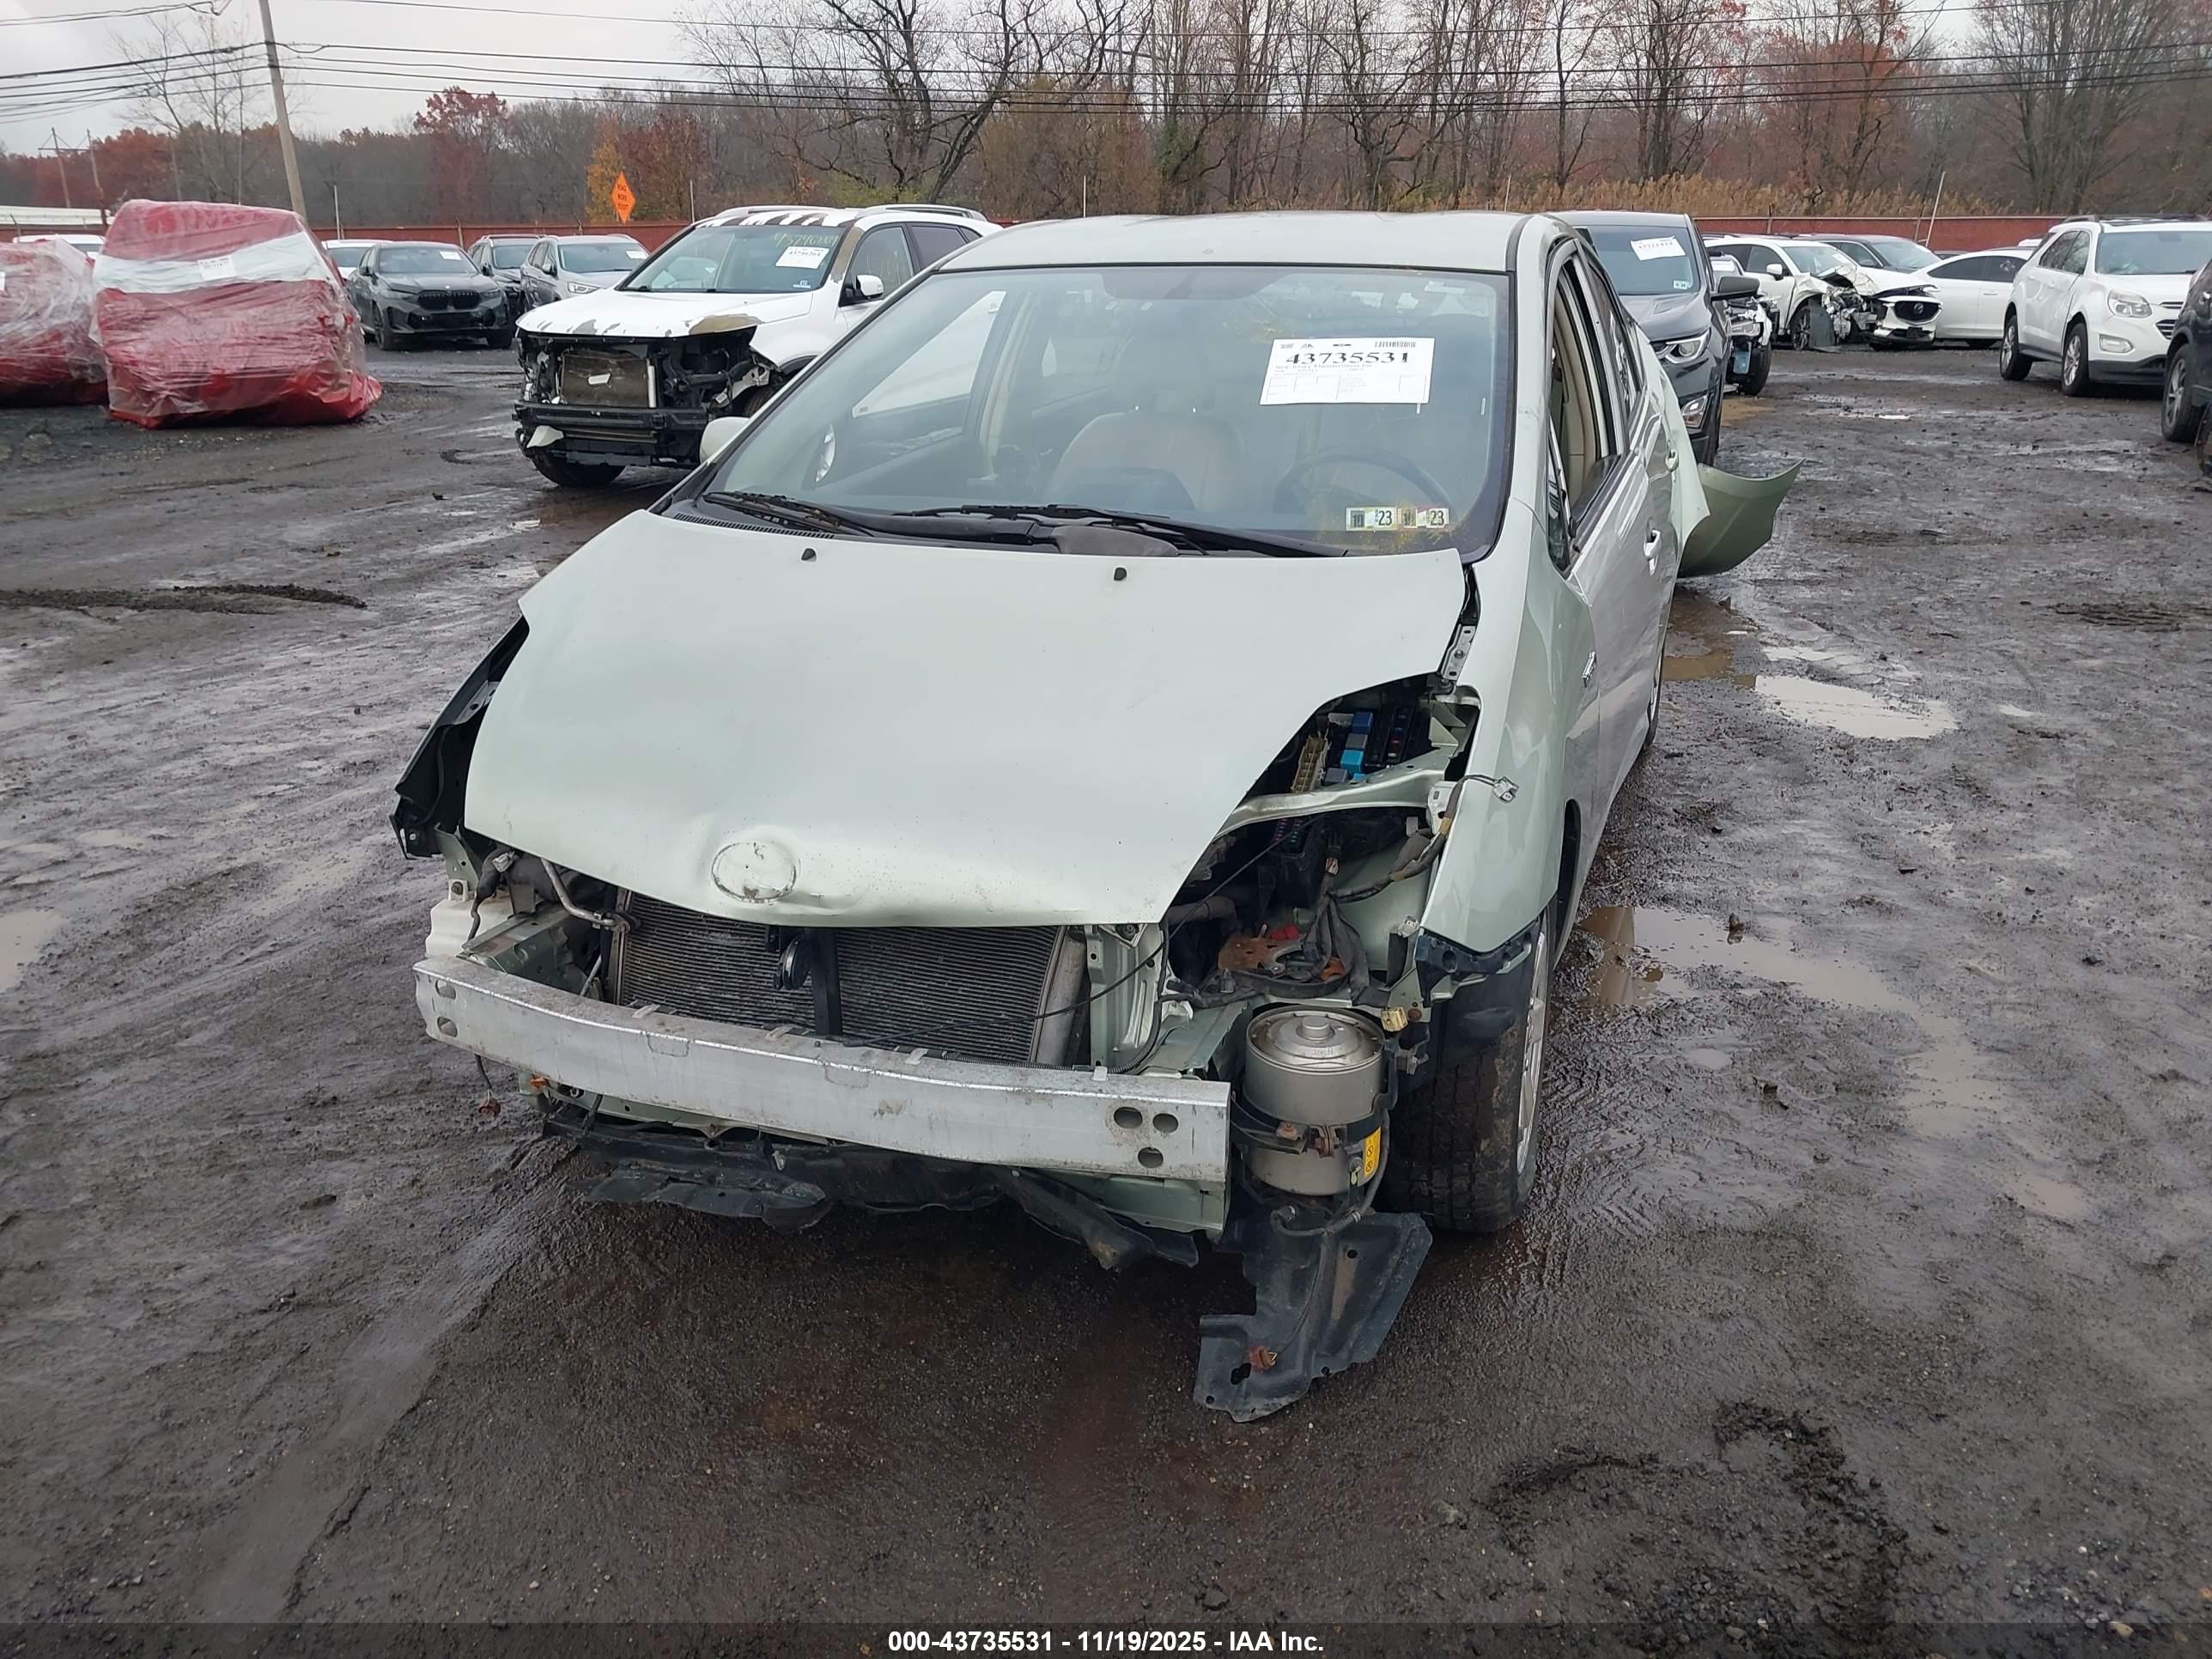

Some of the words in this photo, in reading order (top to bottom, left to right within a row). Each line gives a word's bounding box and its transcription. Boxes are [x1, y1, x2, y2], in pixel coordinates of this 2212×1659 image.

[1286, 352, 1408, 364] 43735531
[1378, 510, 1392, 526] 23
[1431, 510, 1444, 526] 23
